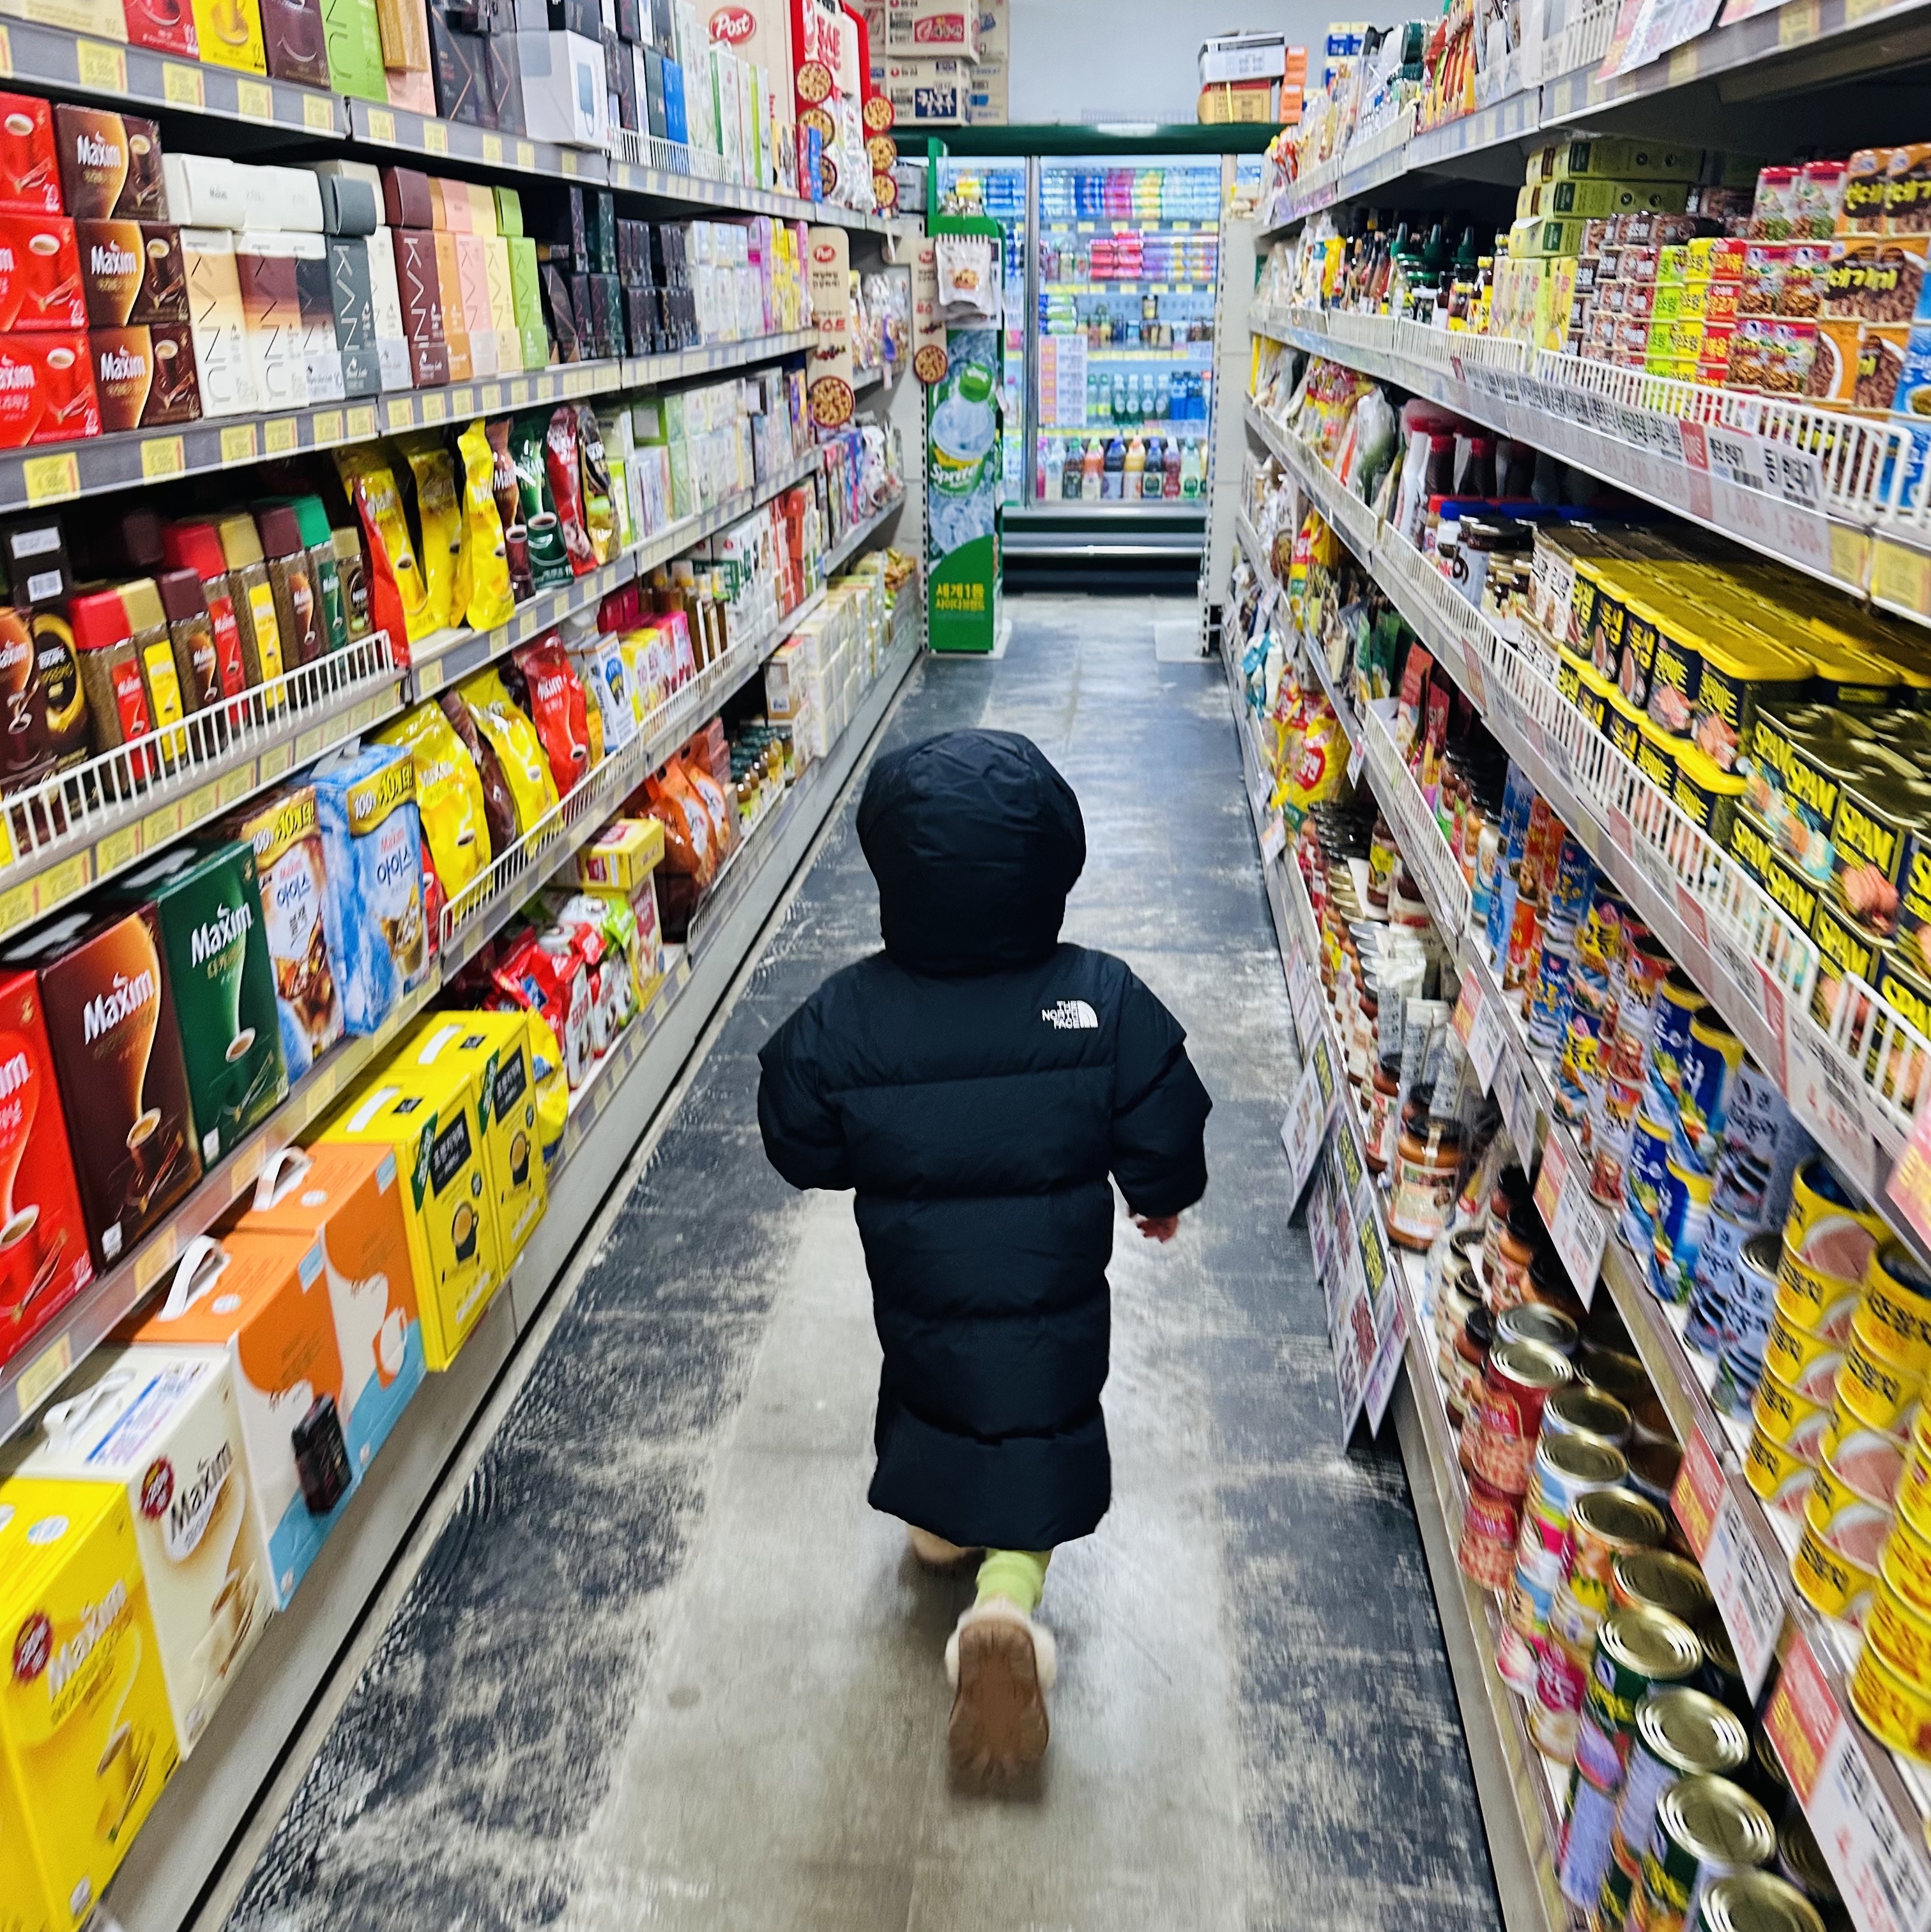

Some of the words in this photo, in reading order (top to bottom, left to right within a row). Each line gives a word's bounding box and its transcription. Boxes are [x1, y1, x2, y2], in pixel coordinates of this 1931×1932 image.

[715, 15, 751, 37] Post
[77, 131, 121, 168] Maxim
[91, 240, 137, 275] Maxim
[333, 245, 360, 351] KAN
[101, 346, 146, 381] Maxim
[930, 462, 979, 488] Sprite
[1786, 757, 1838, 821] SPAM
[1838, 799, 1895, 874] SPAM
[378, 843, 413, 886] 아이스
[277, 871, 311, 909] 아이스
[1765, 861, 1816, 929] SPAM
[191, 902, 254, 968] Maxim
[1818, 909, 1870, 979] SPAM
[83, 969, 155, 1045] Maxim
[1042, 1009, 1078, 1021] NORTH
[1054, 1018, 1080, 1030] FACE
[1057, 1001, 1077, 1010] THE
[172, 1439, 233, 1545] Maxim
[48, 1578, 128, 1705] Maxim
